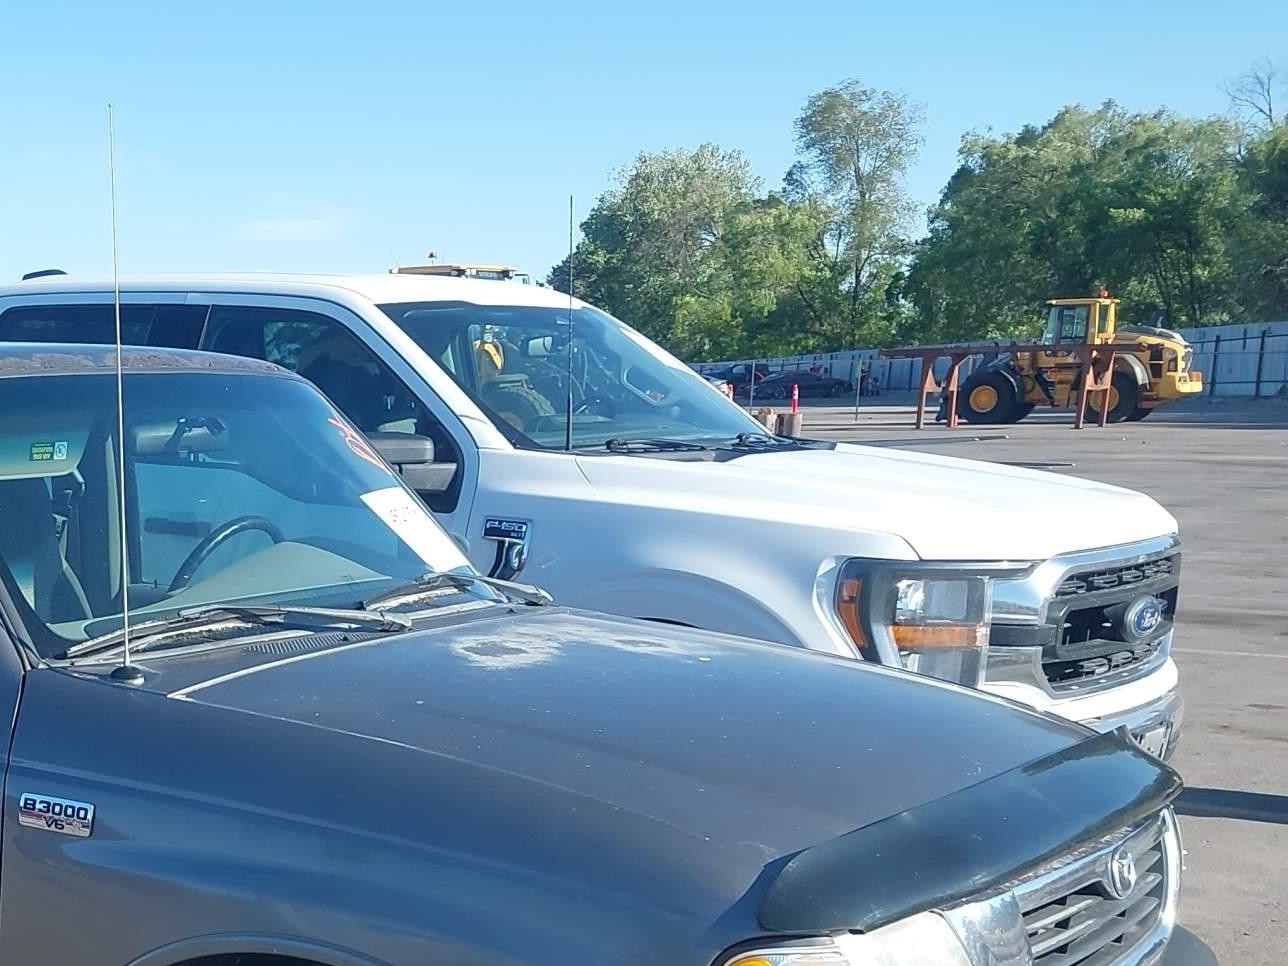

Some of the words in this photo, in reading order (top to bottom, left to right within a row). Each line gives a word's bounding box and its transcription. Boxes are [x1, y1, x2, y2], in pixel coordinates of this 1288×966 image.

[486, 520, 527, 532] F-150
[23, 797, 89, 821] B3000
[43, 816, 65, 830] V6
